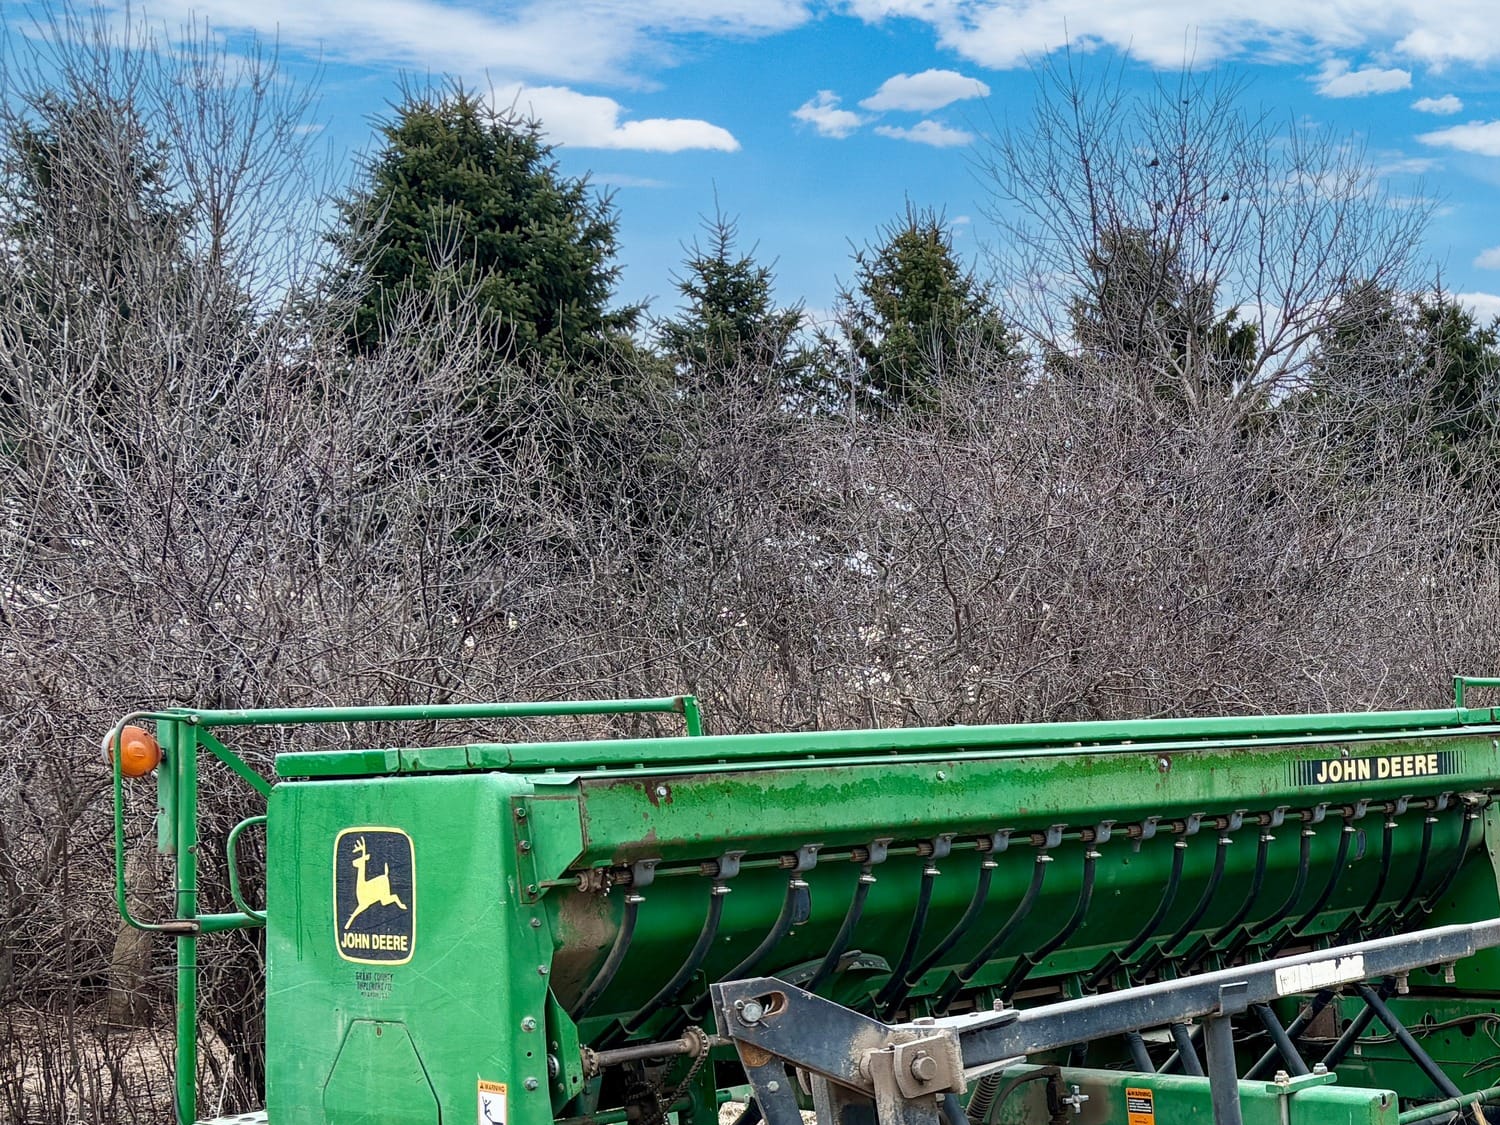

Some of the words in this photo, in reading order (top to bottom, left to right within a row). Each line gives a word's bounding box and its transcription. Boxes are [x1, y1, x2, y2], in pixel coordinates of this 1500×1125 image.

[1317, 758, 1371, 783] JOHN
[1377, 754, 1438, 779] DEERE
[341, 932, 370, 949] JOHN
[372, 934, 409, 952] DEERE
[484, 1083, 505, 1093] WARNING
